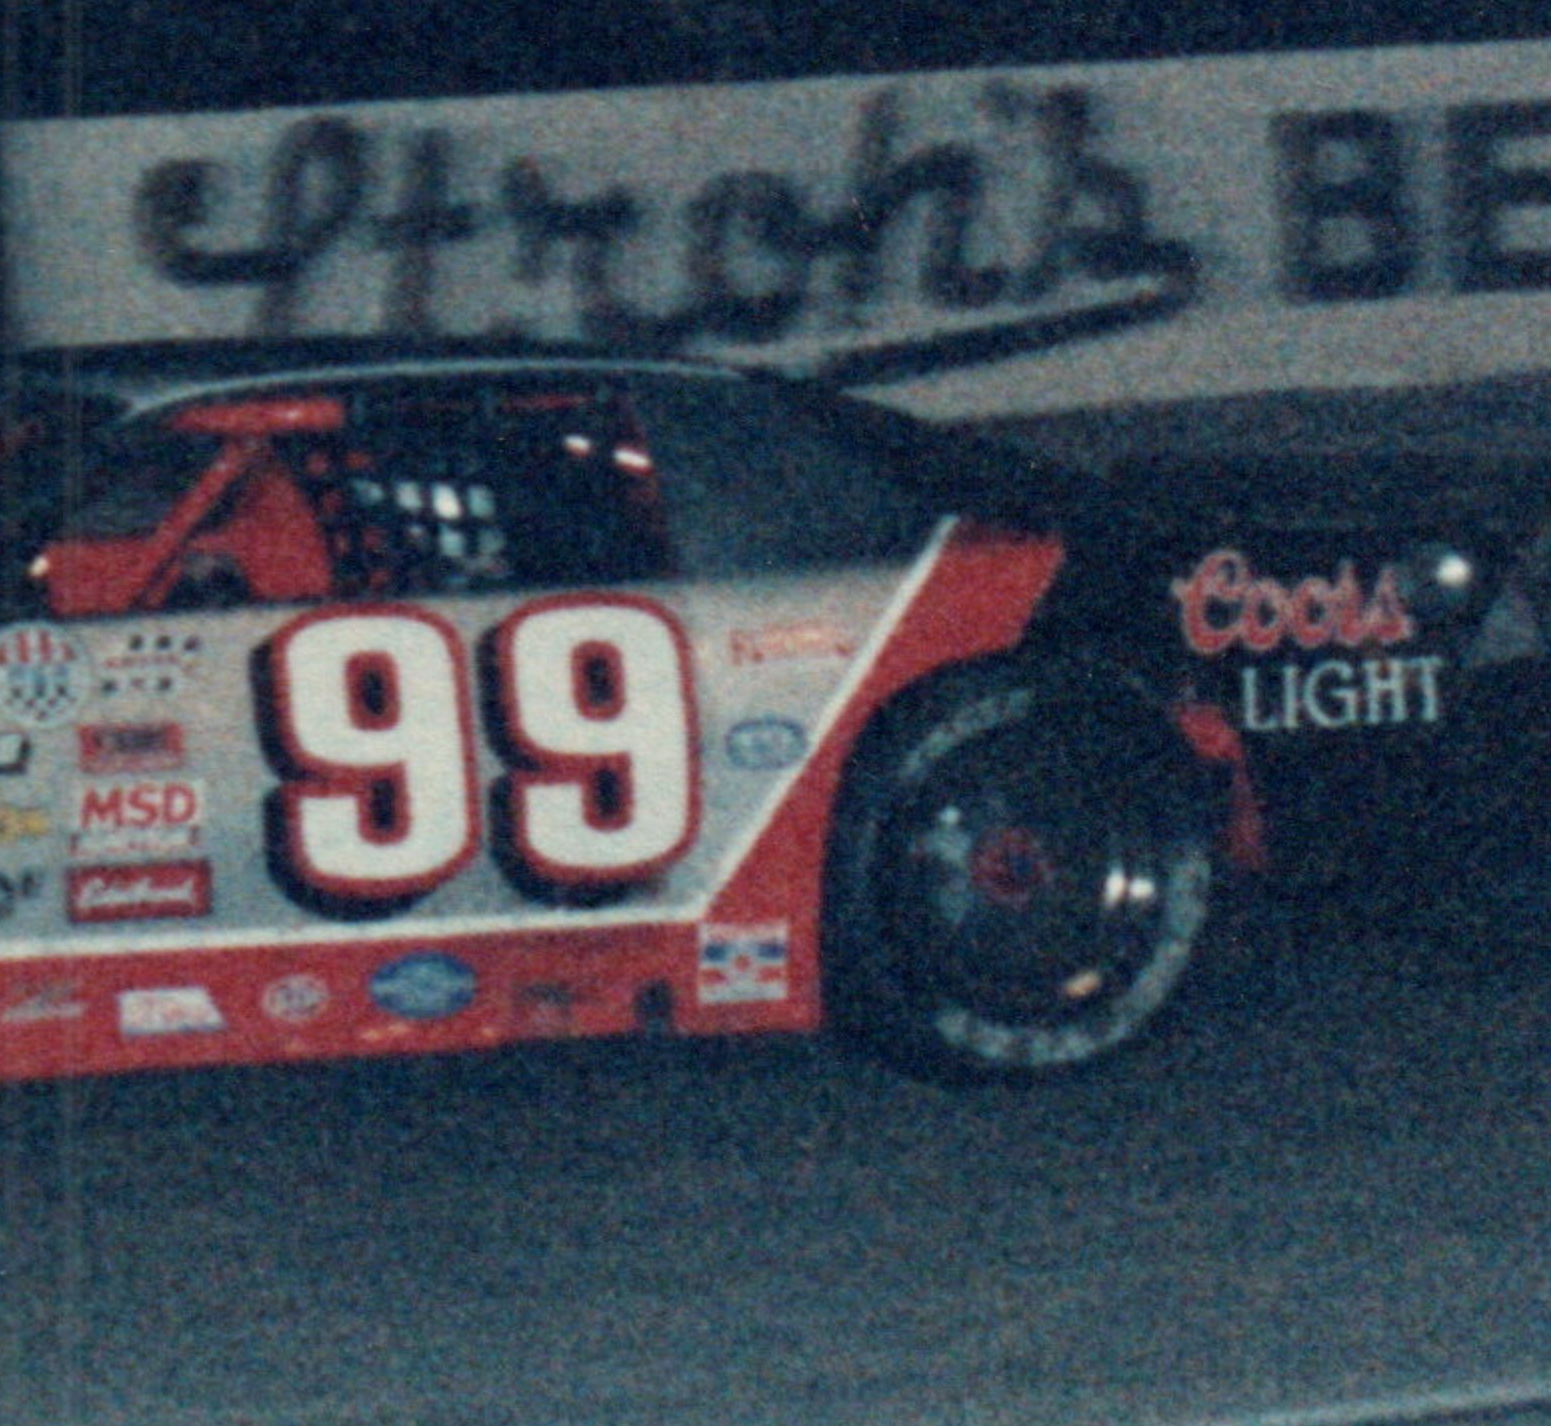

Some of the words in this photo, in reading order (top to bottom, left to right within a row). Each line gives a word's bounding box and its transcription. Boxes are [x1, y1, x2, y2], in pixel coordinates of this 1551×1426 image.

[1169, 547, 1417, 655] Coors
[1240, 655, 1444, 732] LIGHT
[249, 590, 702, 922] 99
[78, 780, 198, 830] MSD
